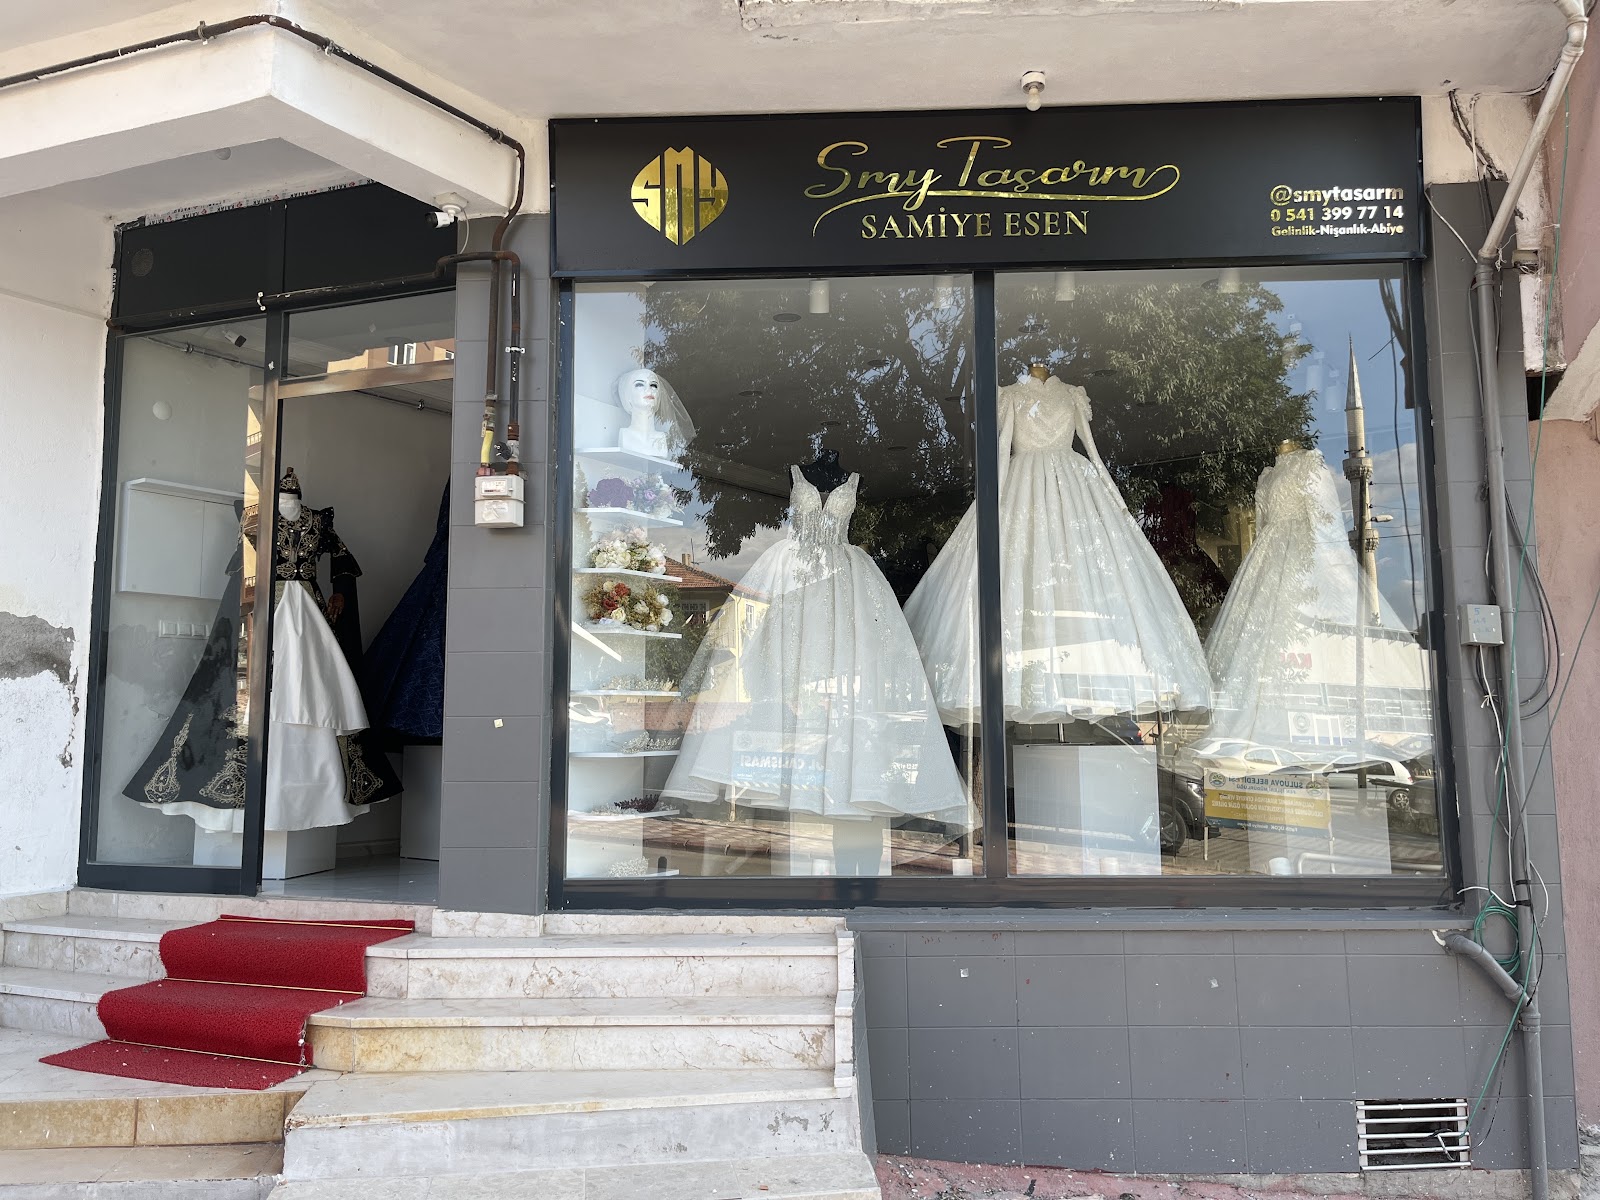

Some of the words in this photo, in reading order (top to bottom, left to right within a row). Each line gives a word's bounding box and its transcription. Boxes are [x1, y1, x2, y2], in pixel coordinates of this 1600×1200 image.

[804, 140, 942, 211] Smy
[860, 206, 993, 240] SAMİYE
[1003, 209, 1090, 236] ESEN
[1270, 208, 1281, 222] 0
[1285, 208, 1315, 222] 541
[1321, 206, 1353, 221] 399
[1357, 205, 1378, 220] 77
[1383, 205, 1405, 219] 14
[1271, 222, 1405, 238] Gelinlik-Nişanlık-Abiye
